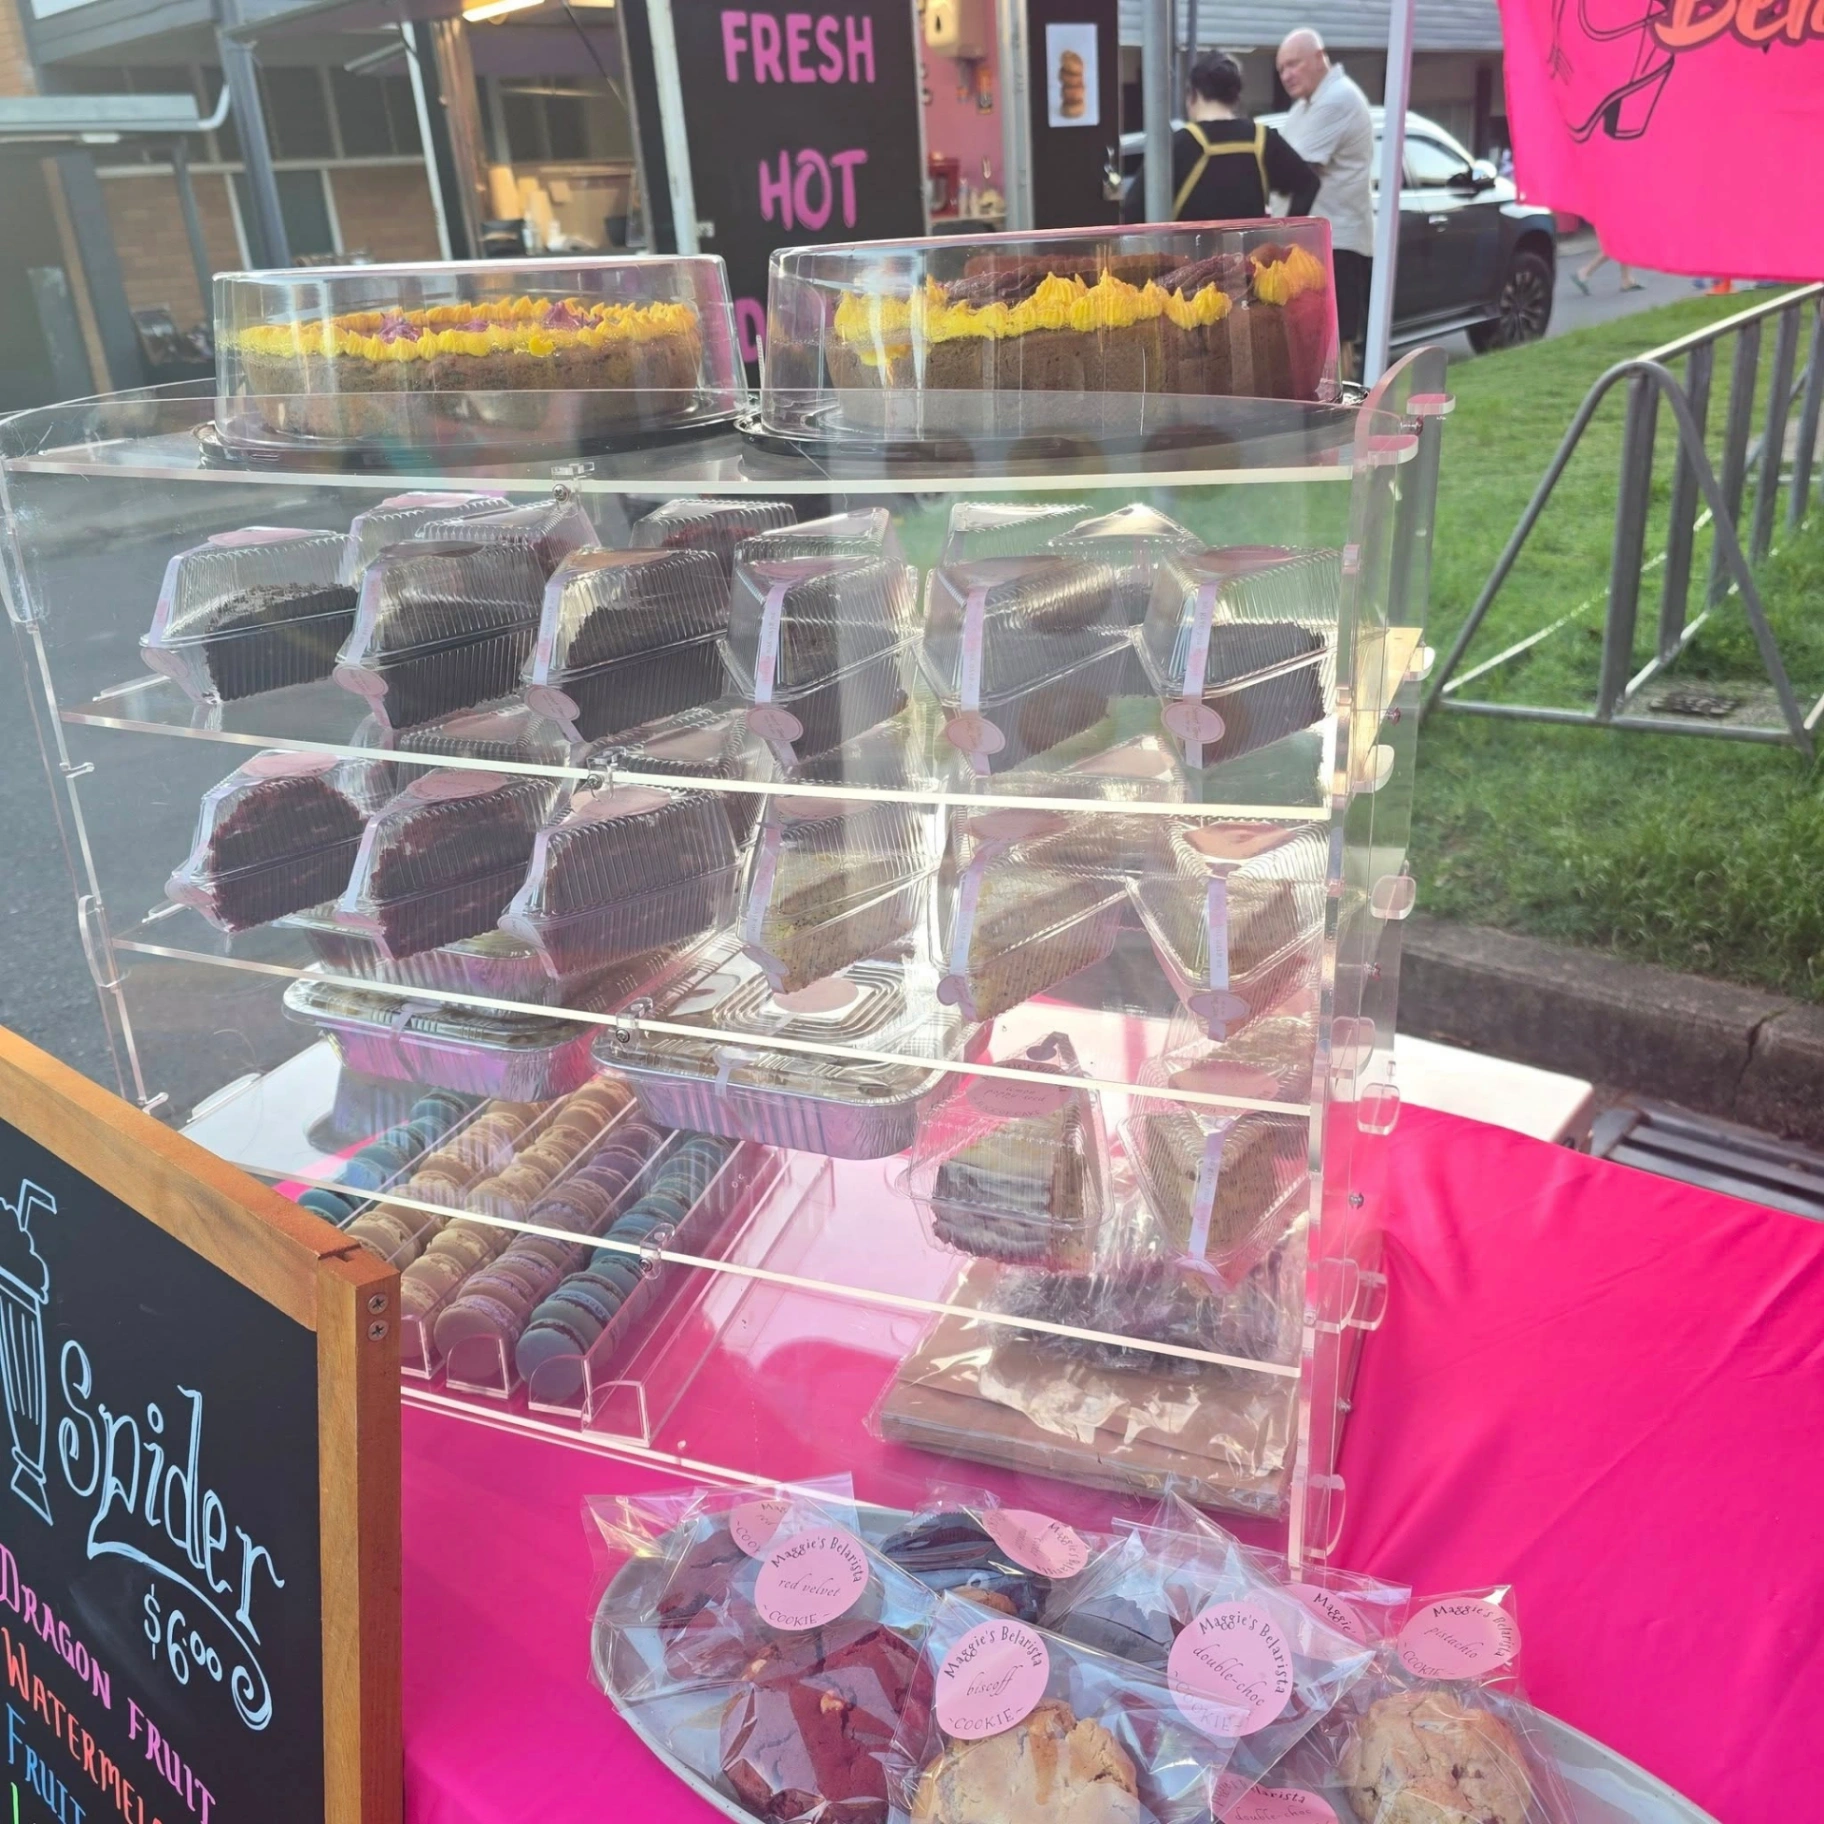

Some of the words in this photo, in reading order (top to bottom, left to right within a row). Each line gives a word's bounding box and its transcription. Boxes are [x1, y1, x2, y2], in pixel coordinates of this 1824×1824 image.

[721, 11, 876, 83] FRESH
[759, 149, 868, 231] HOT
[59, 1340, 285, 1720] Spider
[771, 1537, 826, 1568] Maggie's
[830, 1536, 865, 1583] Belarista
[779, 1573, 813, 1590] red
[802, 1577, 842, 1597] velvet
[769, 1610, 818, 1628] COOKIE
[1314, 1593, 1357, 1634] Maggie'
[1433, 1605, 1494, 1618] Maggie's
[1493, 1616, 1516, 1657] Belarista
[943, 1630, 996, 1680] Maggie's
[1001, 1625, 1044, 1668] Belarista
[1199, 1611, 1259, 1636] Maggie's
[1259, 1623, 1289, 1694] Belarista
[1403, 1650, 1445, 1676] COOKIE
[1424, 1627, 1484, 1659] pistachio
[0, 1543, 111, 1709] DRAGON
[127, 1697, 216, 1824] FRUIT
[966, 1663, 1024, 1697] biscoff
[1192, 1643, 1269, 1707] double-choc
[1, 1627, 164, 1824] WATERMEL
[954, 1707, 1015, 1731] COOKIE
[1176, 1681, 1231, 1732] COOKIE
[6, 1702, 87, 1824] FRUIT
